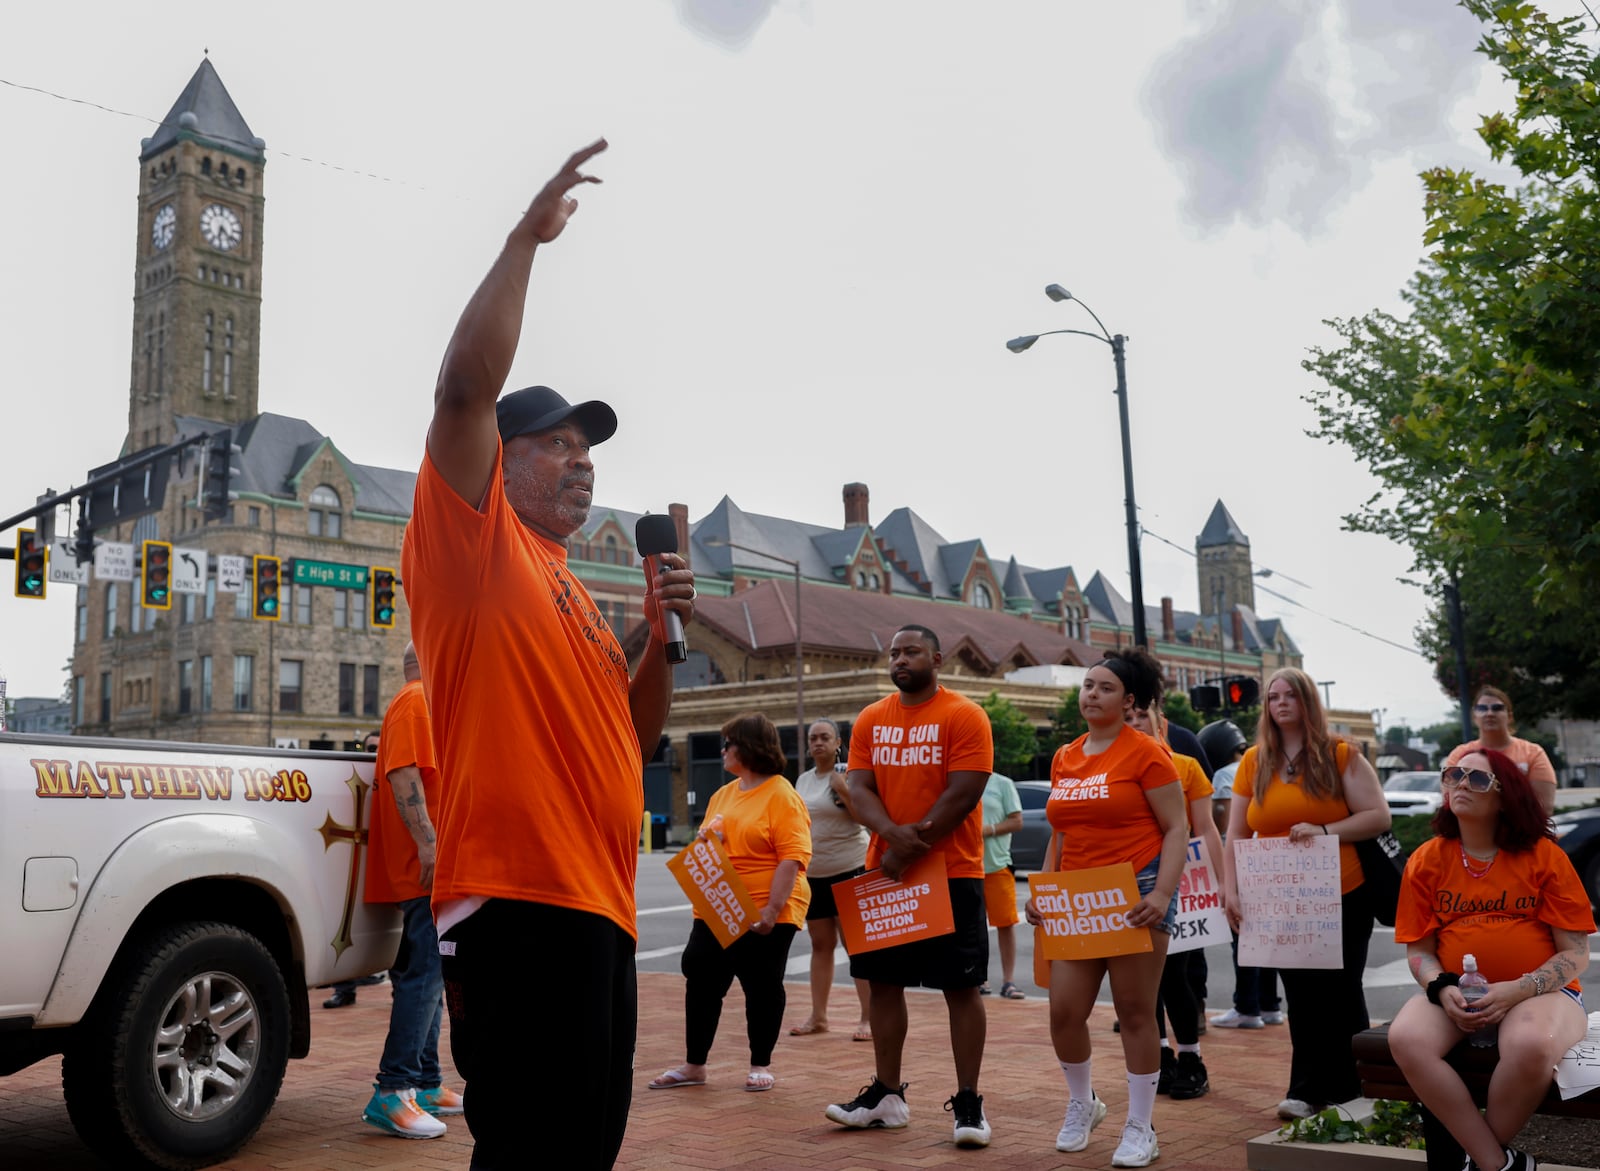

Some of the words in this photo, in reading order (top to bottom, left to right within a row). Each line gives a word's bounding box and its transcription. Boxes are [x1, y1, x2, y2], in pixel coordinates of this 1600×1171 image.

[108, 547, 123, 555] NO
[104, 556, 126, 565] TURN
[223, 558, 240, 568] ONE
[54, 569, 84, 581] ONLY
[113, 568, 130, 576] RED
[297, 565, 305, 577] E
[309, 566, 334, 582] High
[339, 569, 351, 582] St
[356, 571, 365, 583] W
[174, 578, 202, 589] ONLY
[872, 725, 904, 744] END
[908, 723, 939, 744] GUN
[870, 745, 943, 766] VIOLENCE
[30, 759, 234, 801] MATTHEW
[239, 767, 312, 802] 16:16
[1057, 778, 1081, 788] END
[1080, 772, 1108, 787] GUN
[1048, 785, 1110, 801] VIOLENCE
[1235, 842, 1255, 853] THE
[1303, 838, 1316, 849] OF
[1247, 855, 1288, 873] BULLET
[1296, 855, 1337, 871] HOLES
[694, 842, 725, 883] end
[716, 880, 746, 923] gun
[1252, 874, 1269, 885] THIS
[1273, 873, 1306, 884] POSTER
[683, 851, 740, 936] violence
[857, 883, 931, 910] STUDENTS
[1276, 887, 1294, 898] THE
[1298, 887, 1335, 897] NUMBER
[1036, 889, 1072, 913] end
[1073, 888, 1127, 916] gun
[1180, 893, 1218, 913] FROM
[1244, 903, 1271, 915] THAT
[1273, 903, 1290, 915] CAN
[1296, 903, 1309, 915] BE
[1313, 903, 1341, 915] SHOT
[1432, 890, 1508, 914] Blessed
[860, 899, 919, 922] DEMAND
[864, 912, 914, 934] ACTION
[1245, 921, 1253, 932] IN
[1257, 921, 1273, 931] THE
[1276, 920, 1299, 931] TIME
[1305, 921, 1313, 931] IT
[1317, 921, 1339, 931] TAKES
[1259, 935, 1268, 945] TO
[1276, 934, 1298, 945] READ
[1303, 933, 1314, 944] IT
